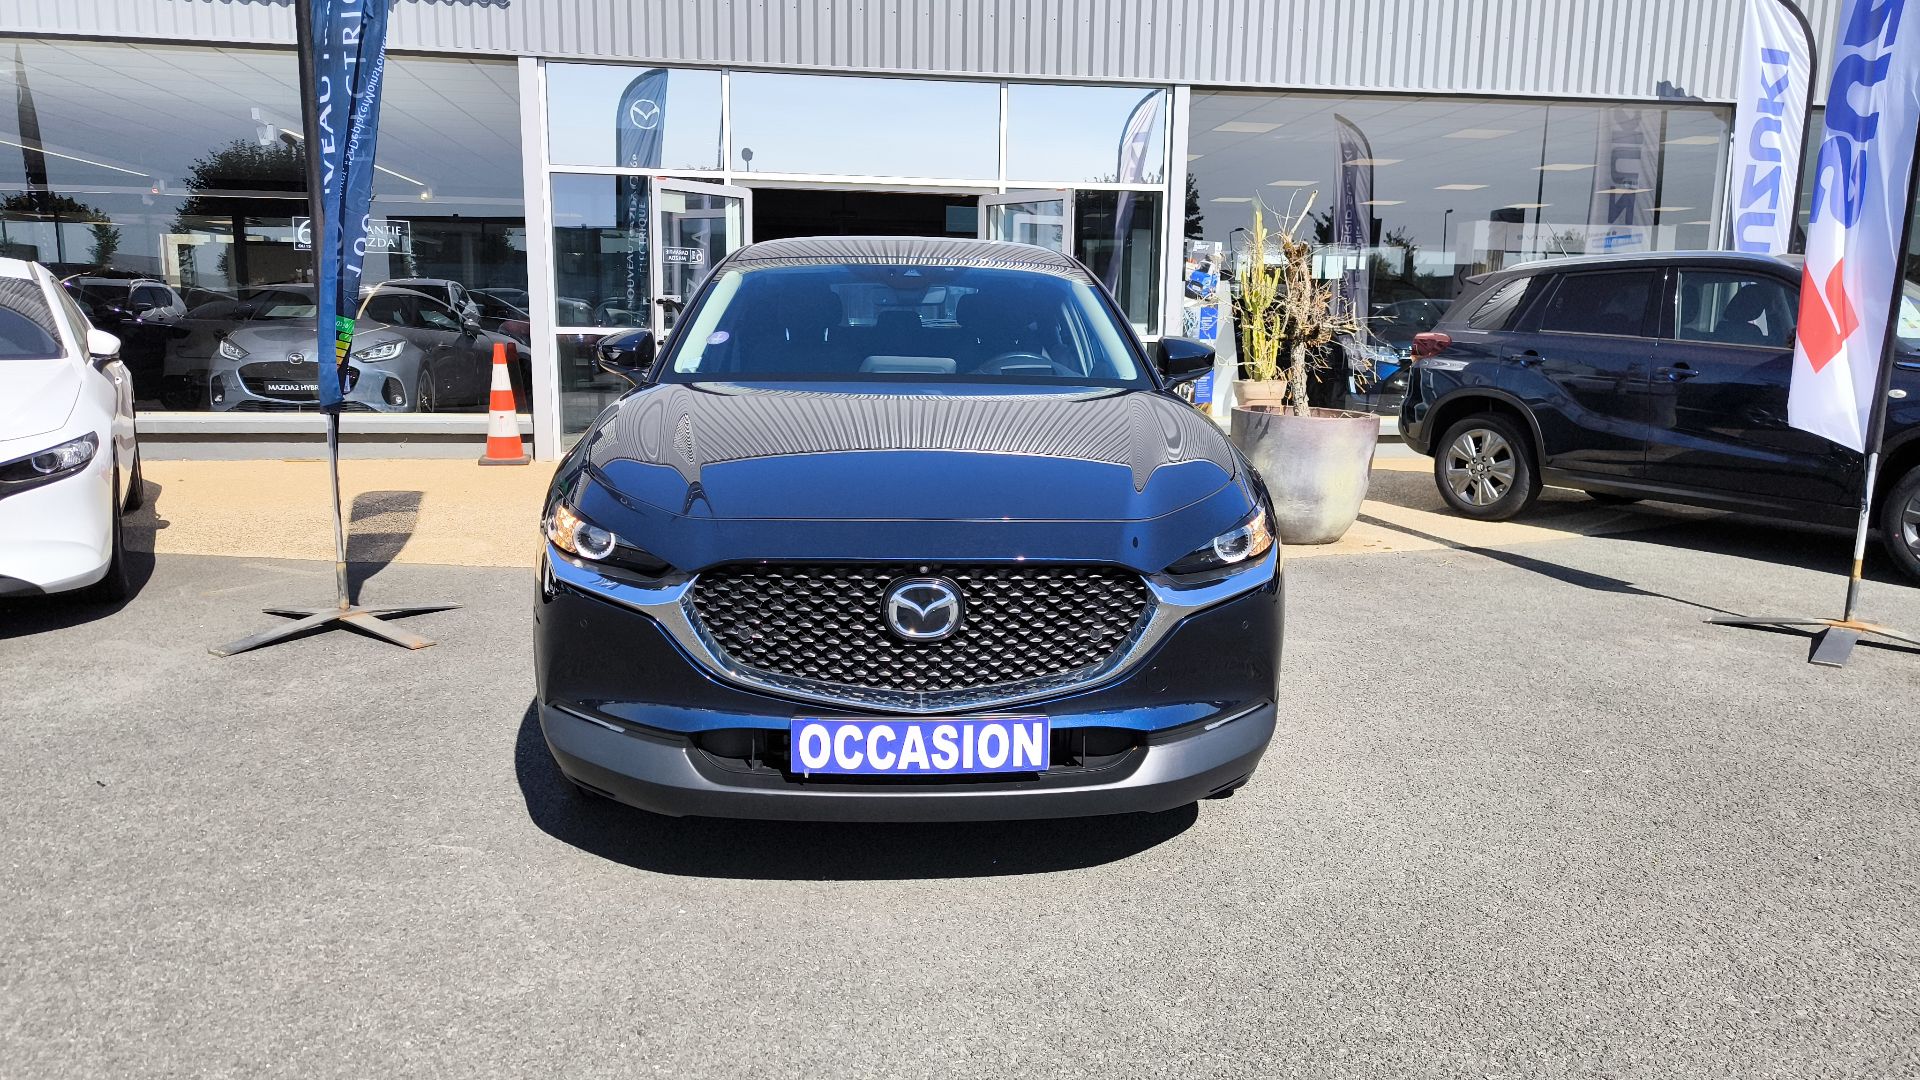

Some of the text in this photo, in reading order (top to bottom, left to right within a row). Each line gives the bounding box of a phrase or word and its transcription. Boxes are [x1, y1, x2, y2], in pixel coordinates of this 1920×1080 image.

[367, 225, 402, 236] ANTIE
[365, 237, 396, 248] ZDA
[799, 723, 1043, 770] OCCASION
